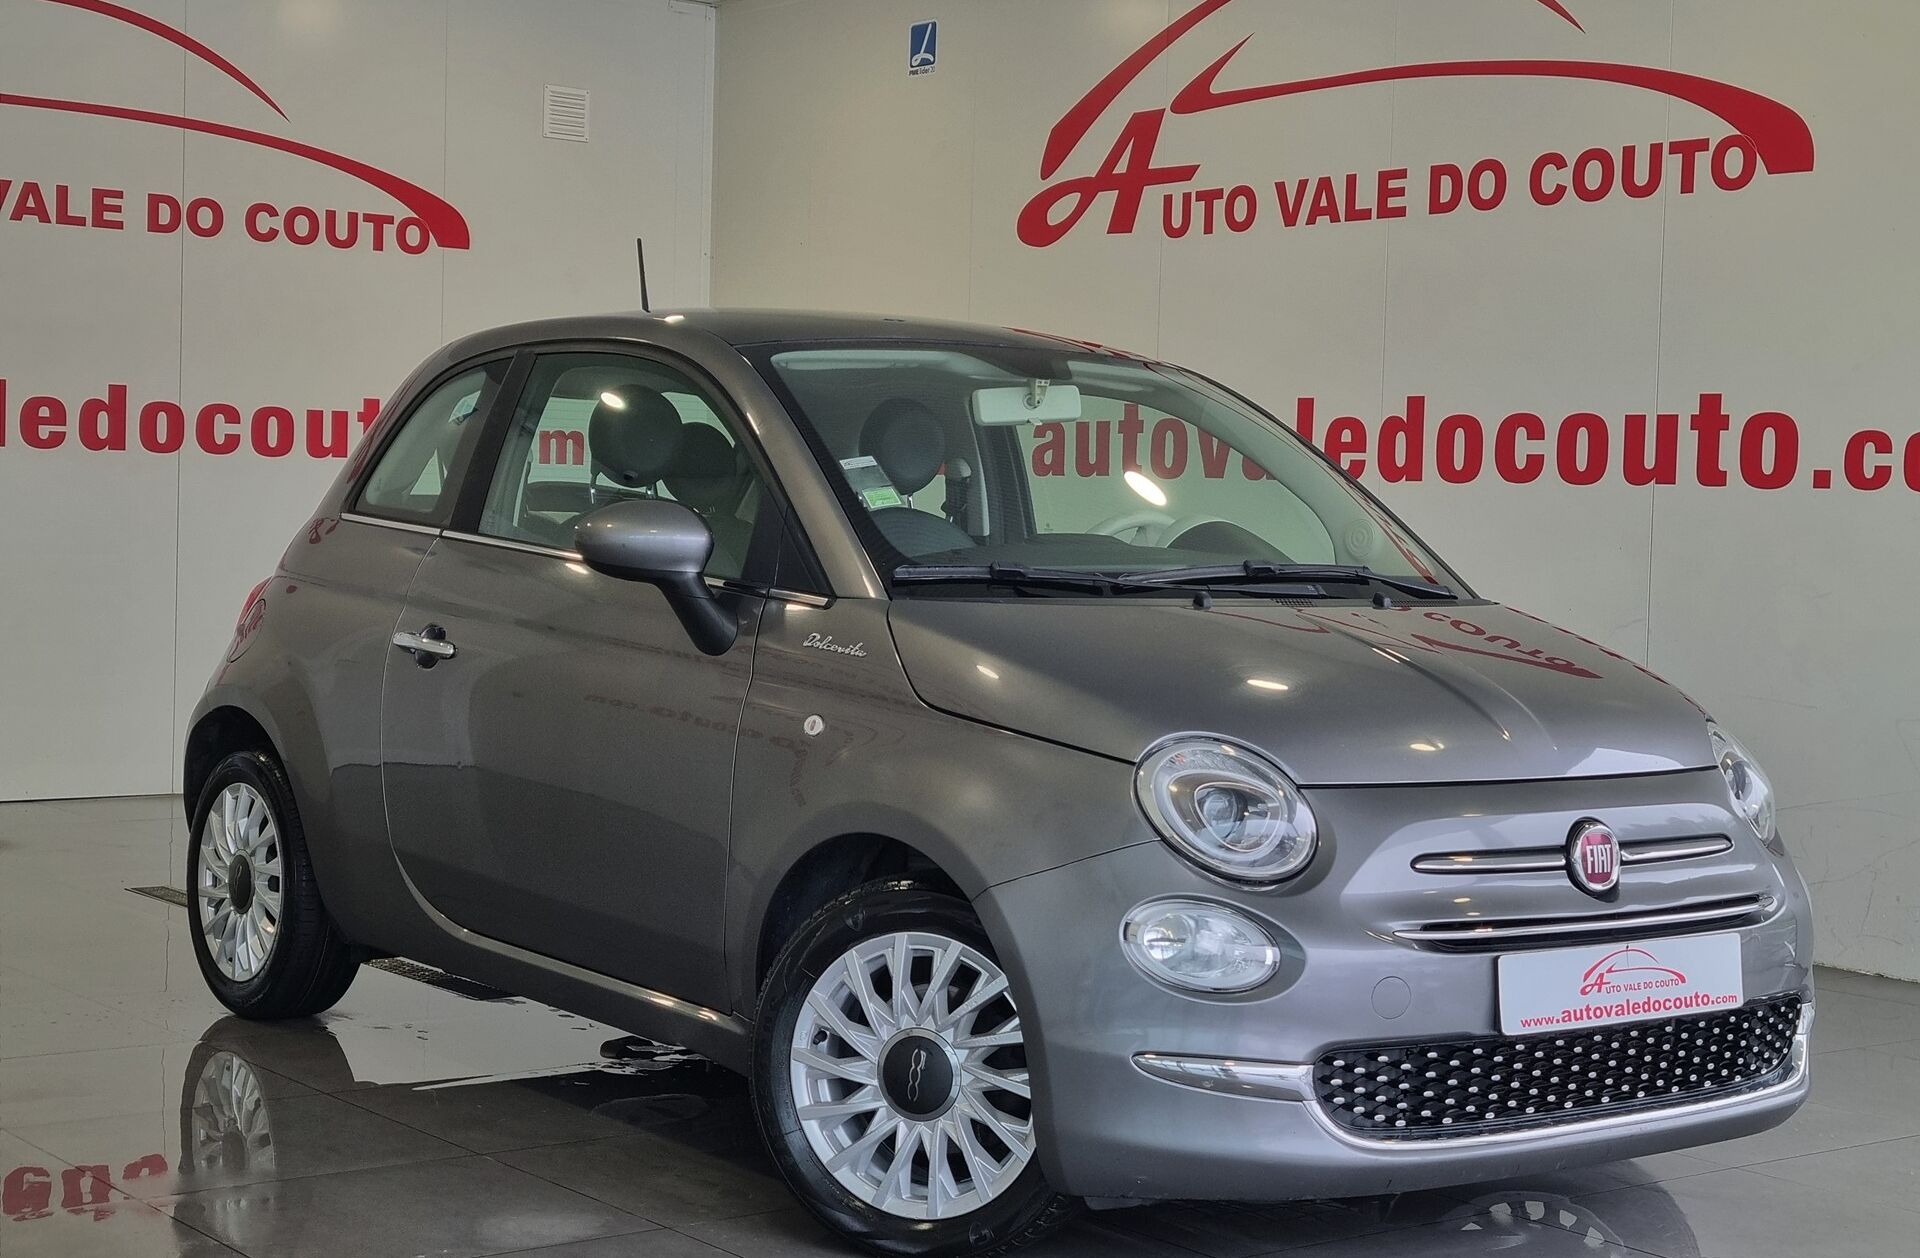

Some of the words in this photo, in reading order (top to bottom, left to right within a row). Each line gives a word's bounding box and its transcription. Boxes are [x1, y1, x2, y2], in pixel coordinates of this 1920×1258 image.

[1274, 167, 1409, 229] VALE
[1427, 157, 1508, 216] DO
[1528, 134, 1758, 207] COUTO
[146, 192, 225, 238] DO
[244, 202, 431, 255] COUTO
[1586, 843, 1612, 874] FIAT
[1623, 981, 1641, 992] VALE
[1643, 980, 1654, 990] DO
[1654, 978, 1680, 989] COUTO
[1520, 991, 1738, 1028] www.autovaledocouto.com
